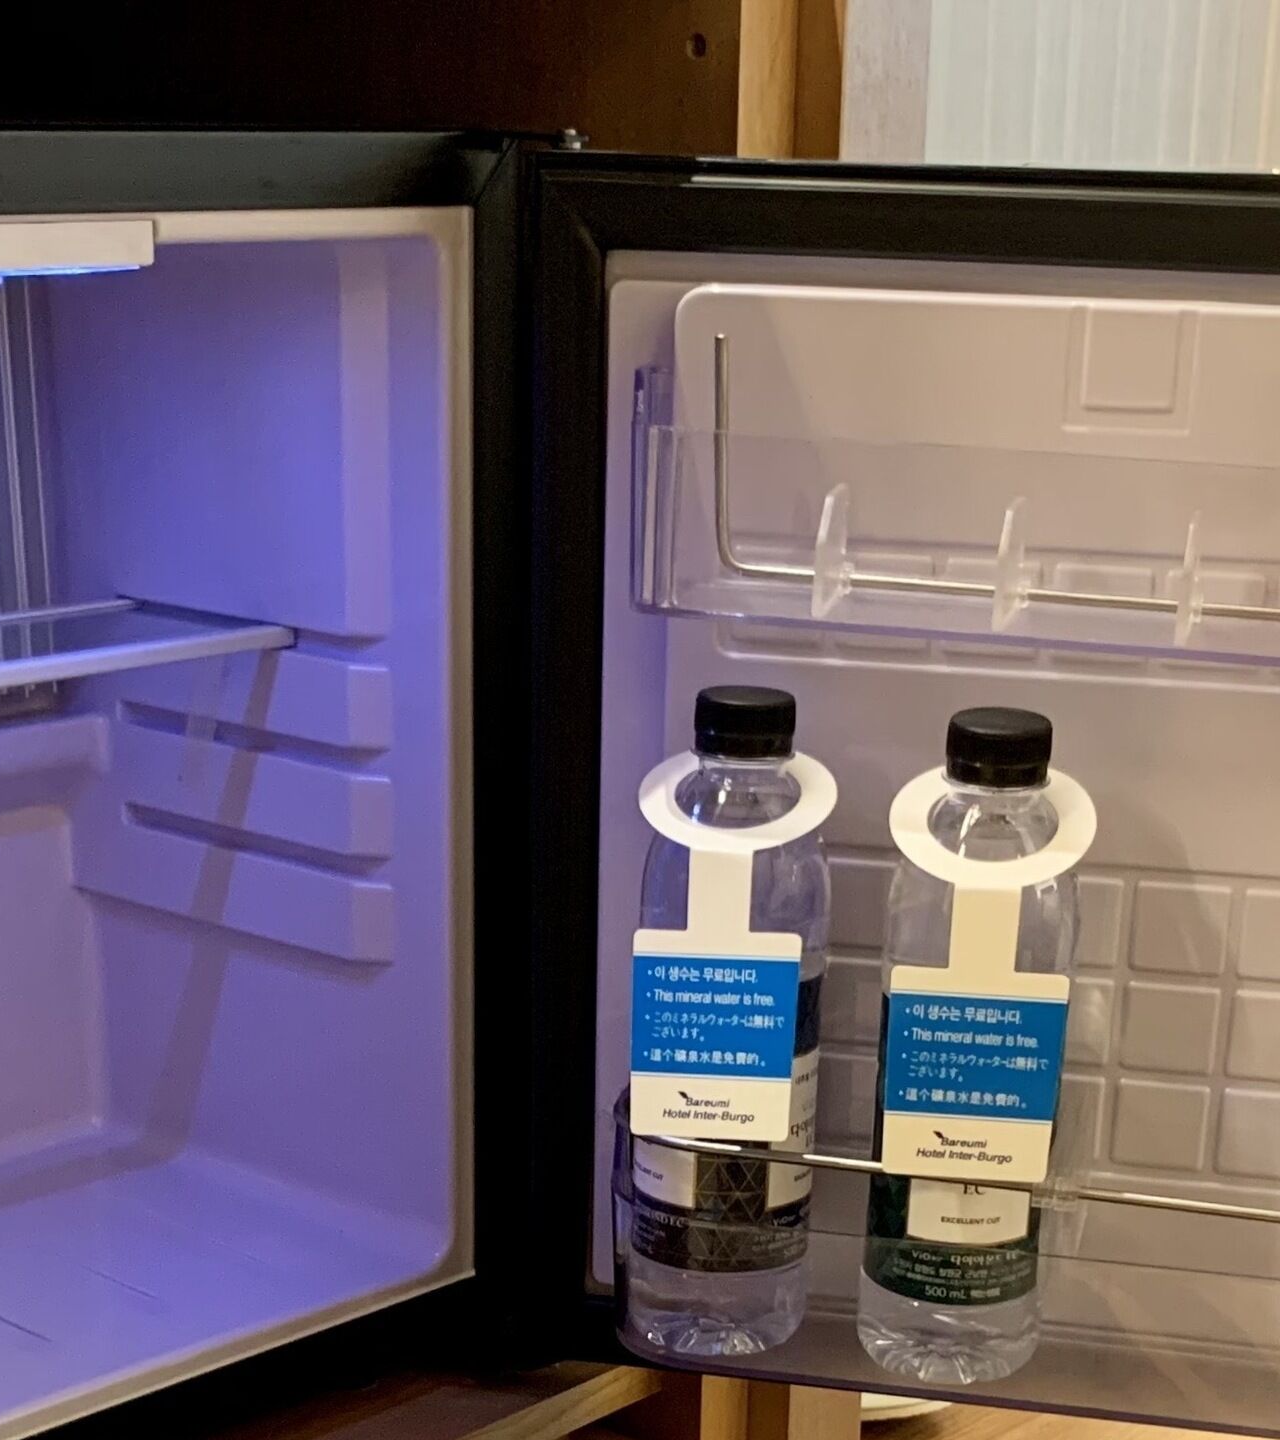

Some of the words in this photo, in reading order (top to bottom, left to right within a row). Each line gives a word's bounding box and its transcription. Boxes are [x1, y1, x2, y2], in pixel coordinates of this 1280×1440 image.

[654, 965, 665, 980] 이
[668, 966, 700, 982] 생수는
[654, 988, 673, 1003] This
[675, 991, 712, 1004] mineral
[714, 992, 741, 1006] water
[743, 993, 752, 1006] is
[912, 1004, 925, 1019] 이
[928, 1004, 962, 1022] 생수는
[911, 1027, 933, 1041] This
[934, 1030, 973, 1044] mineral
[975, 1033, 1003, 1046] water
[1005, 1033, 1015, 1047] is
[686, 1097, 730, 1108] Bareumi
[663, 1109, 691, 1120] Hotel
[693, 1110, 755, 1123] Inter-Burgo
[941, 1137, 987, 1148] Bareumi
[916, 1147, 946, 1160] Hotel
[948, 1149, 1013, 1165] Inter-Burgo
[924, 1285, 947, 1298] 500
